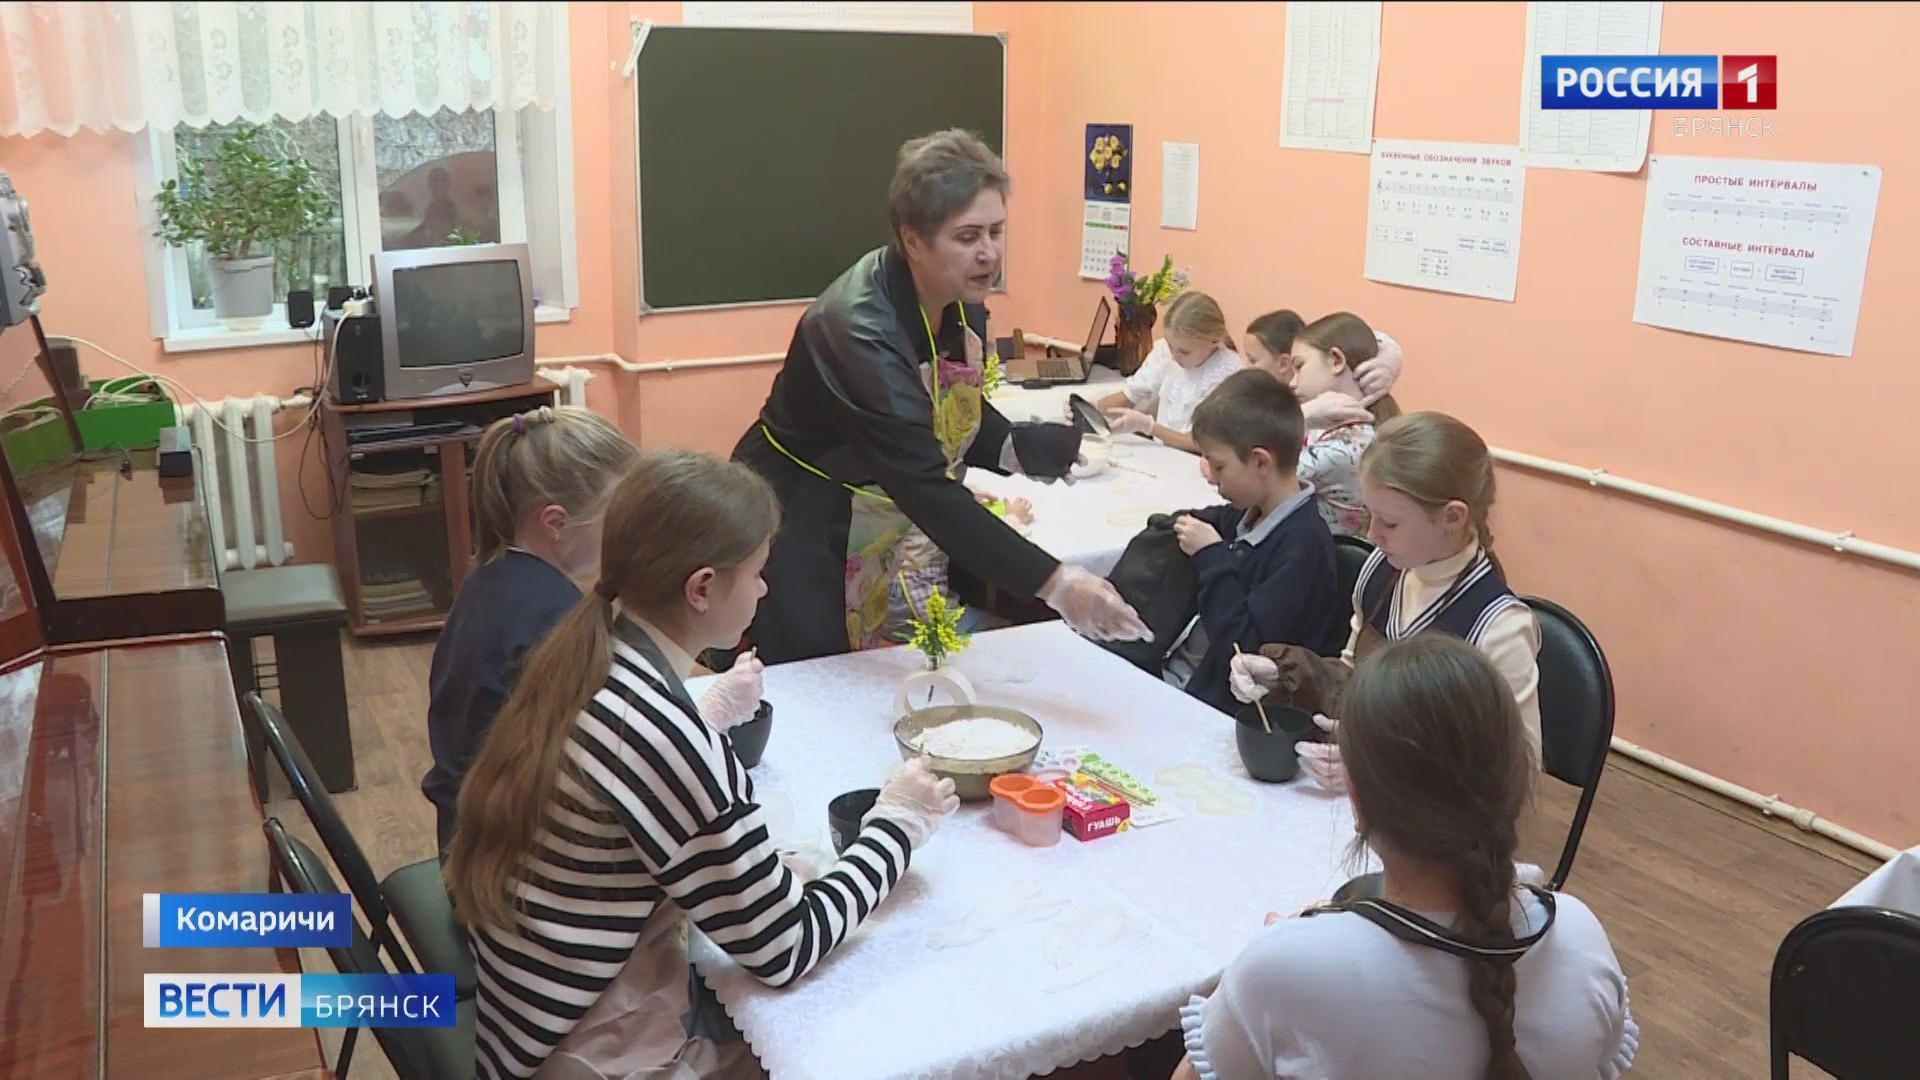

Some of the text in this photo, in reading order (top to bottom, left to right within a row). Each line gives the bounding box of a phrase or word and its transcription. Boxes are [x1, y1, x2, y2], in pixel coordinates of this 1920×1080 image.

[1381, 151, 1512, 166] БУКВЕННЫЕ ОБОЗНАЧЕНИЯ ЗВУКОВ
[1694, 175, 1817, 192] ПРОСТЫЕ ИНТЕРВАЛЫ
[1682, 237, 1815, 259] СОСТАВНЫЕ ИНТЕРВАЛЫ
[1087, 815, 1121, 832] ГУАШЬ
